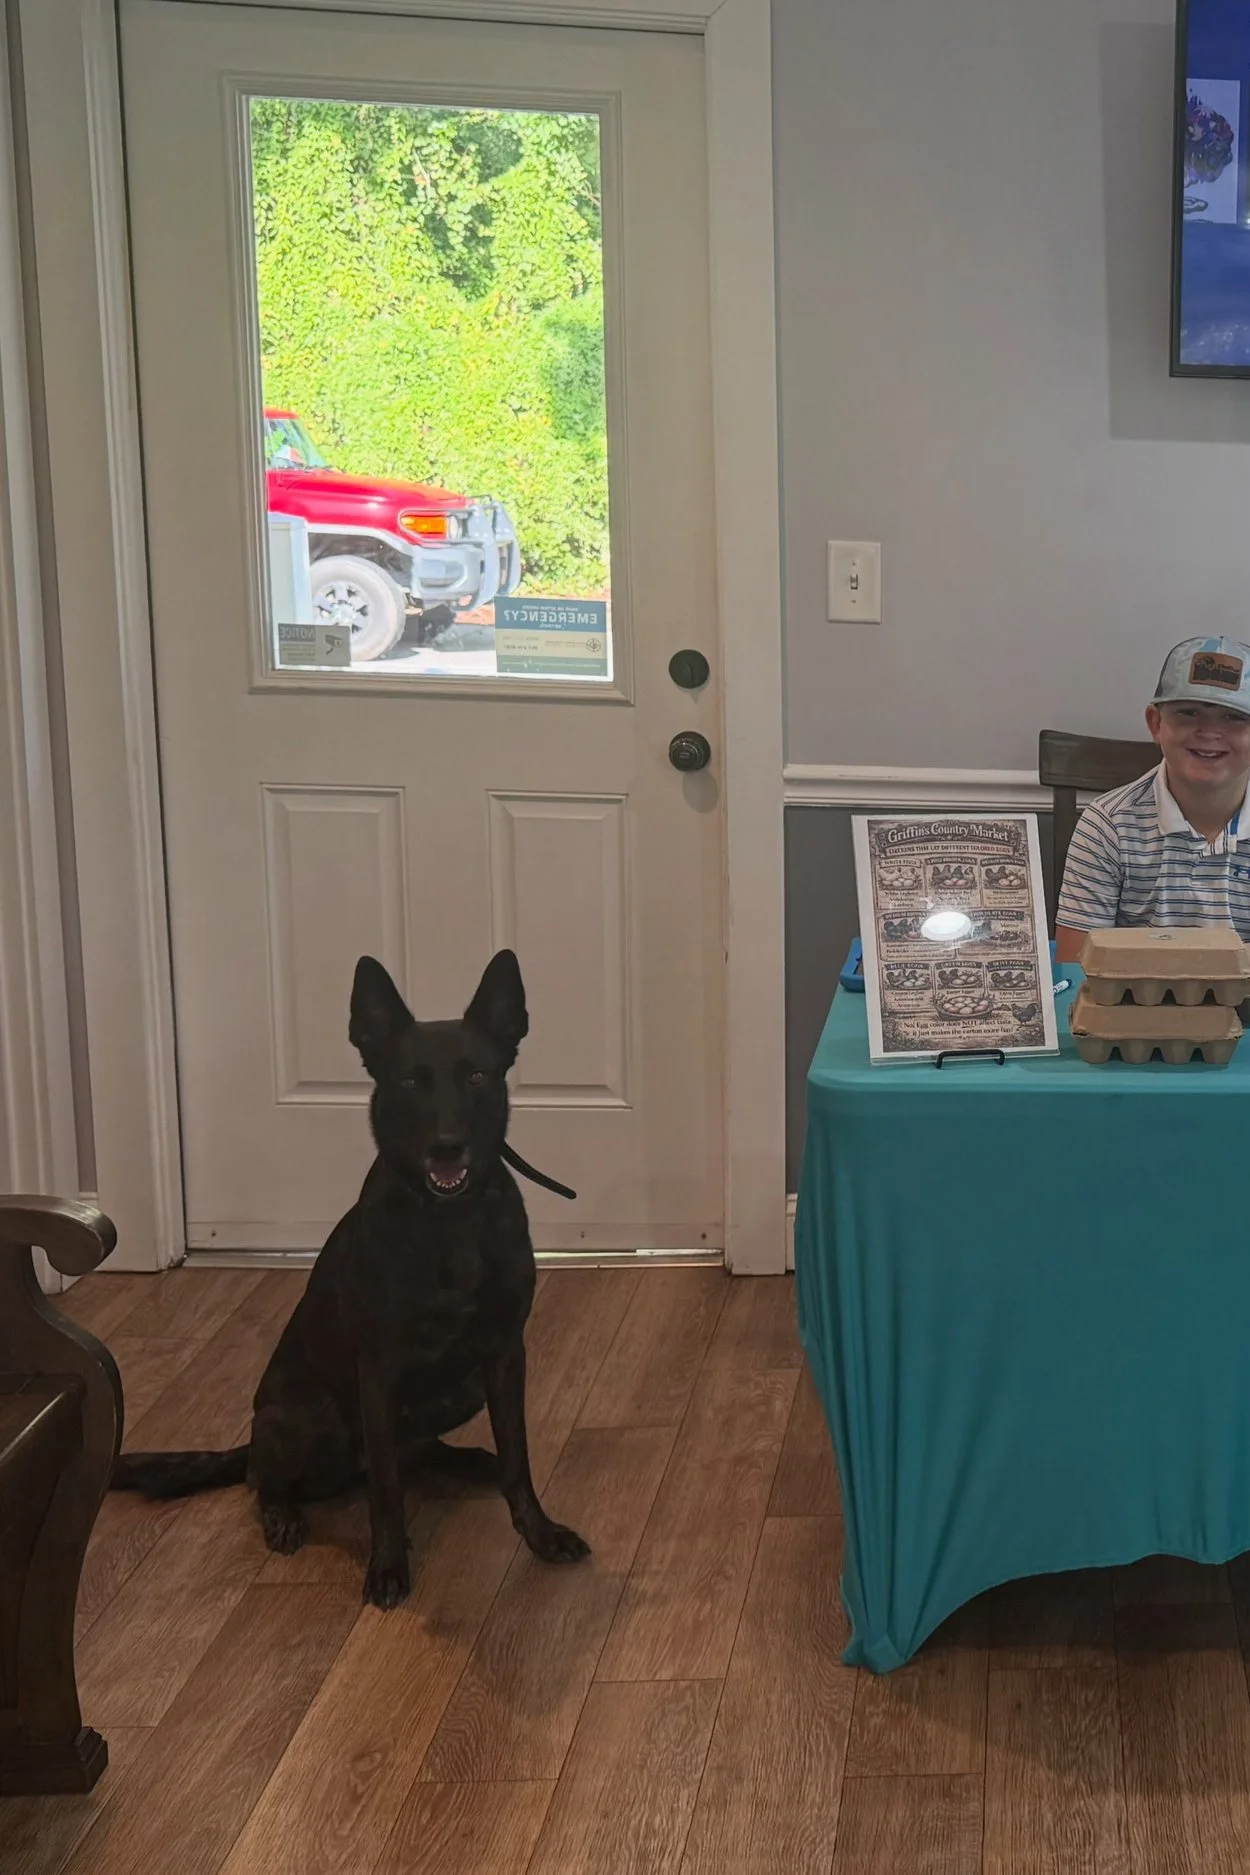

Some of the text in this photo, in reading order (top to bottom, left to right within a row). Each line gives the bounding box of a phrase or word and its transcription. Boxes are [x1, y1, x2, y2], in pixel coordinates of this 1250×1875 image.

[888, 823, 1009, 843] Griffin's Country Market
